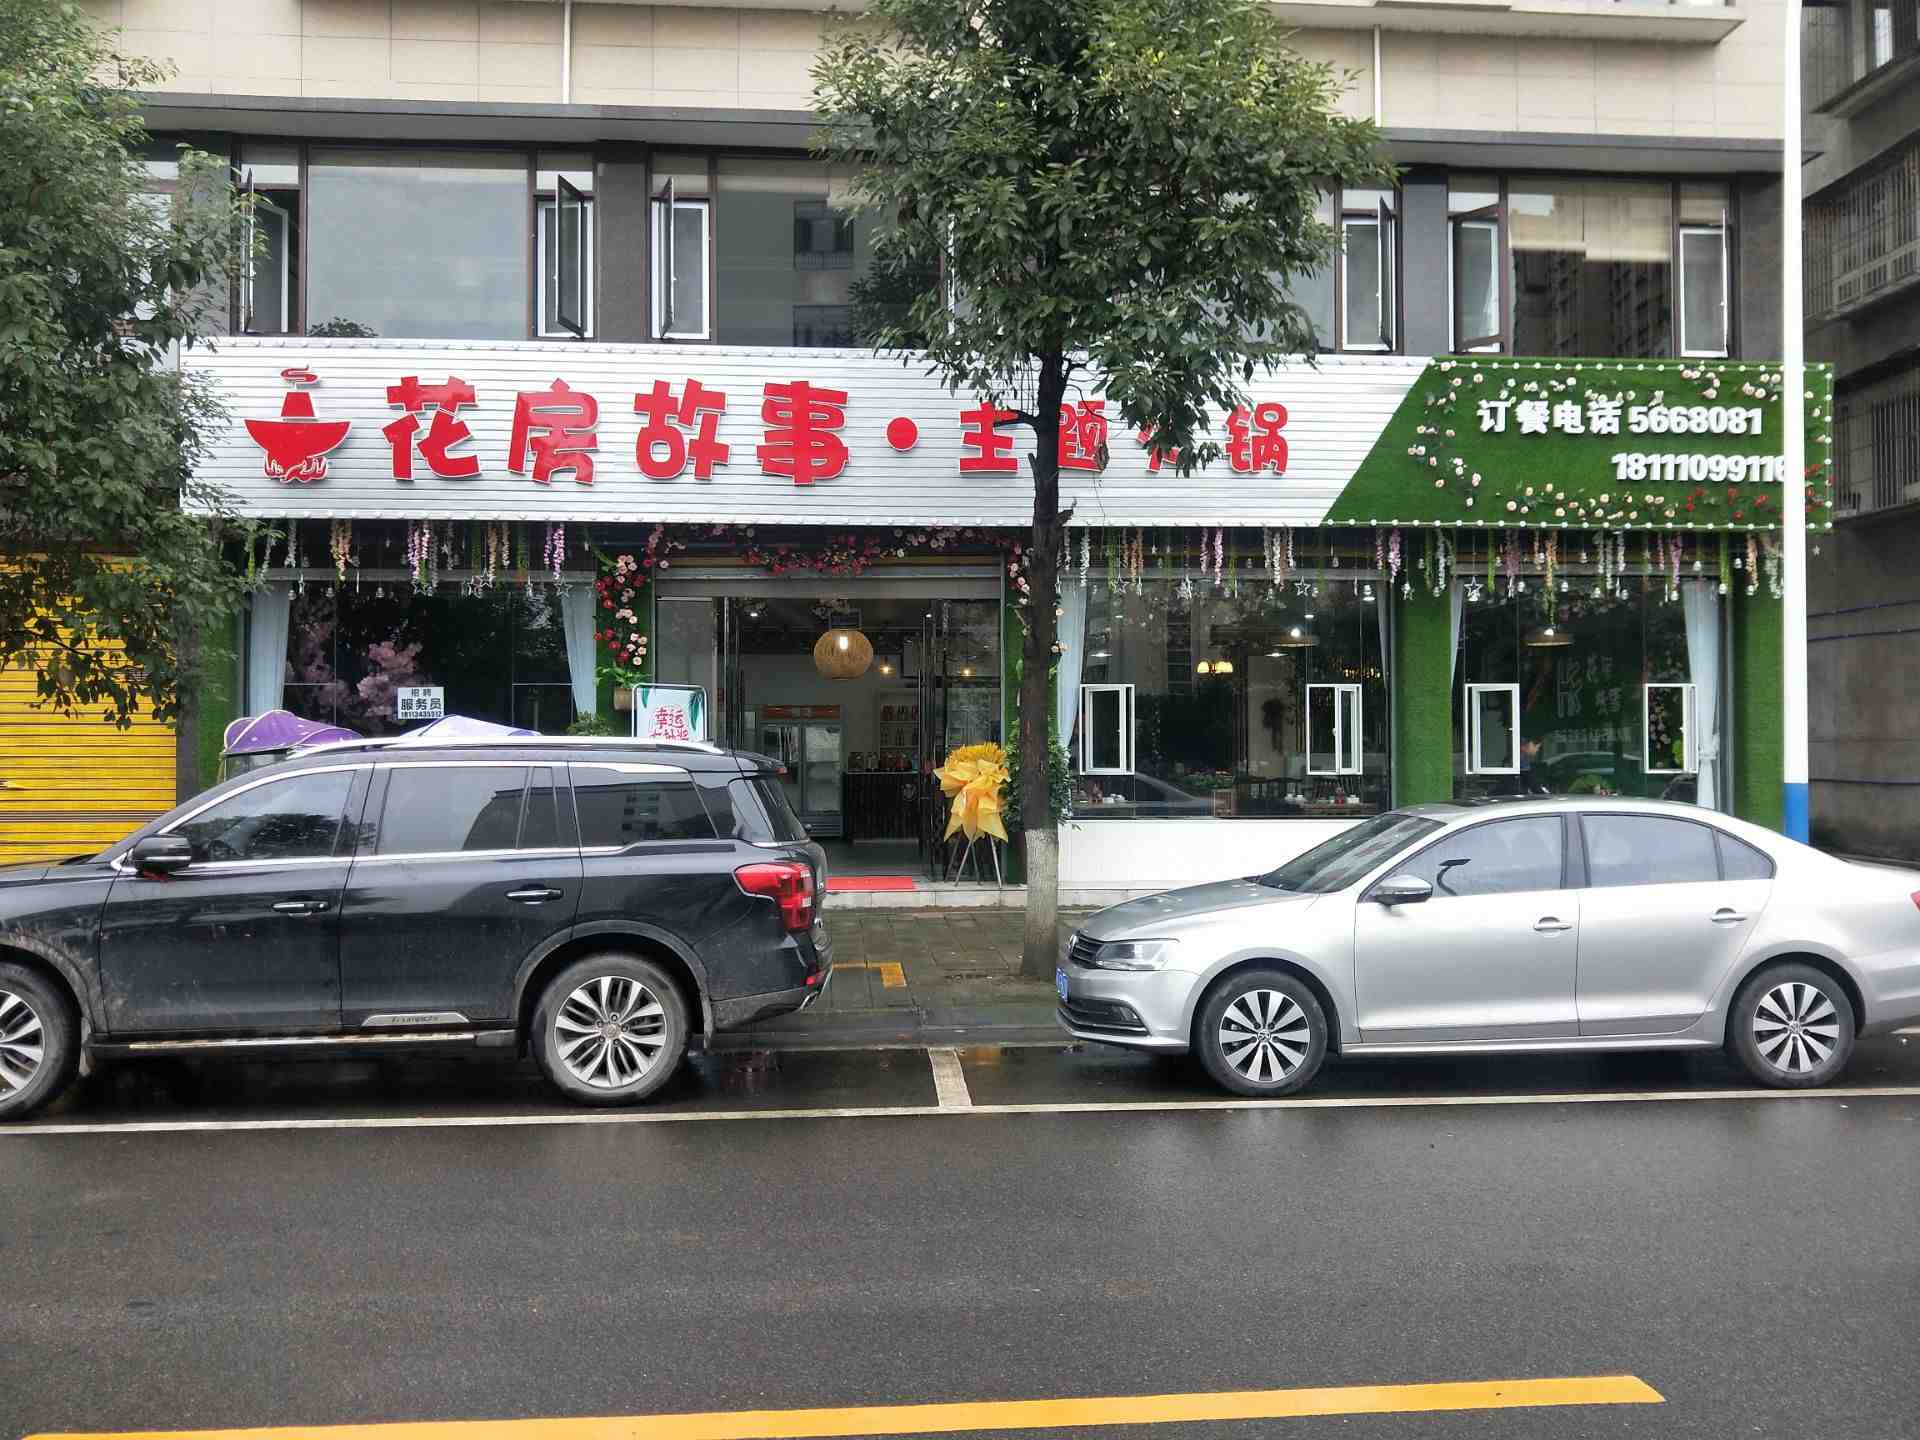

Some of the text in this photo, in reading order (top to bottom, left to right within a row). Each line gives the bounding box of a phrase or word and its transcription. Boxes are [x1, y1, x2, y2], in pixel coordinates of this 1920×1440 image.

[381, 376, 1289, 486] 花房故事·主题锅
[400, 697, 442, 711] 服务员
[655, 707, 685, 729] 幸运
